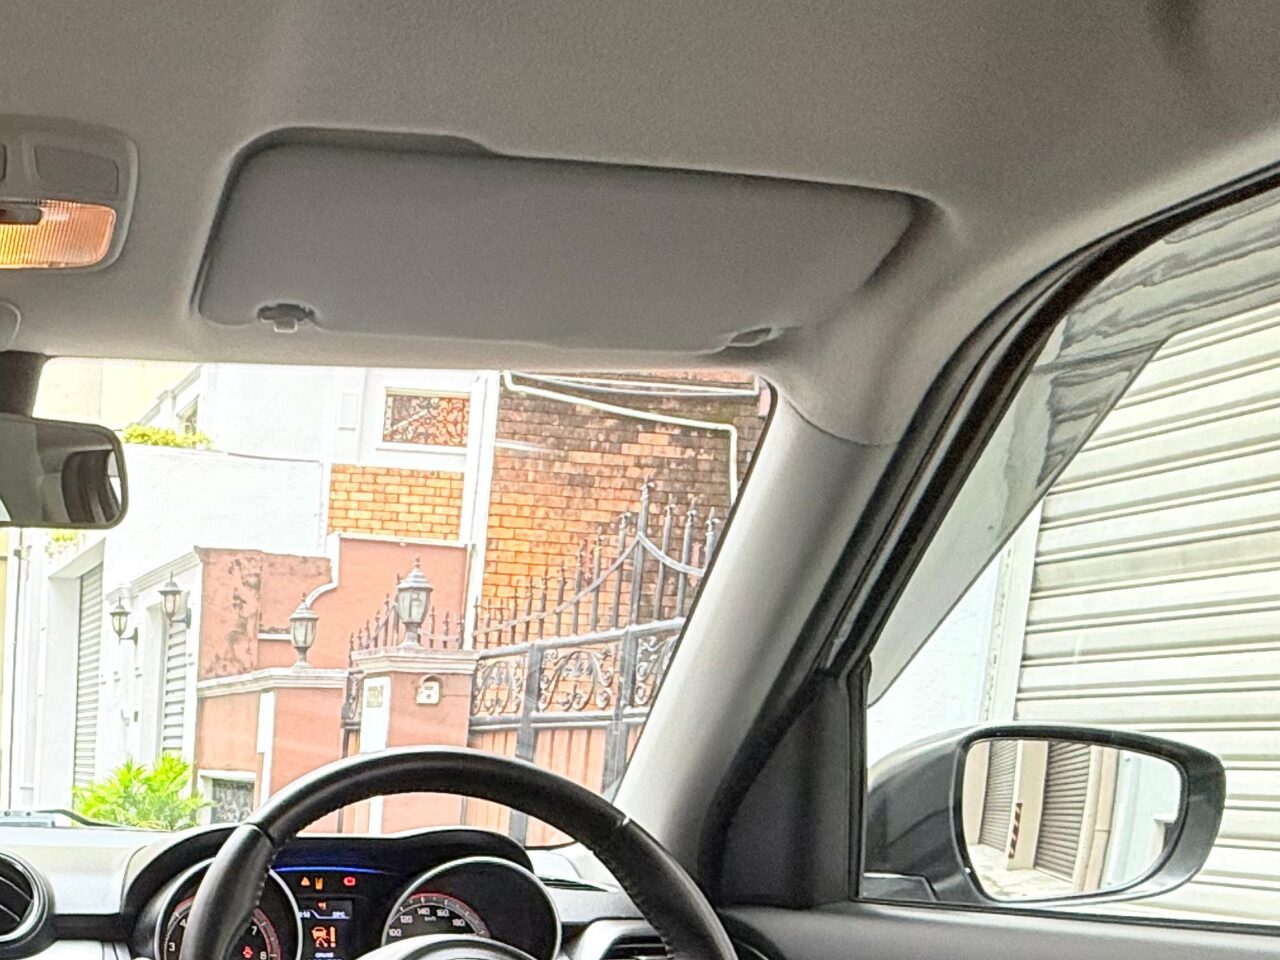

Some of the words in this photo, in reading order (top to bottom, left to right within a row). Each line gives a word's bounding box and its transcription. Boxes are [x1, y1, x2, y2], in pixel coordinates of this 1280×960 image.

[251, 926, 258, 936] 7
[388, 929, 402, 937] 100
[168, 942, 176, 952] 3
